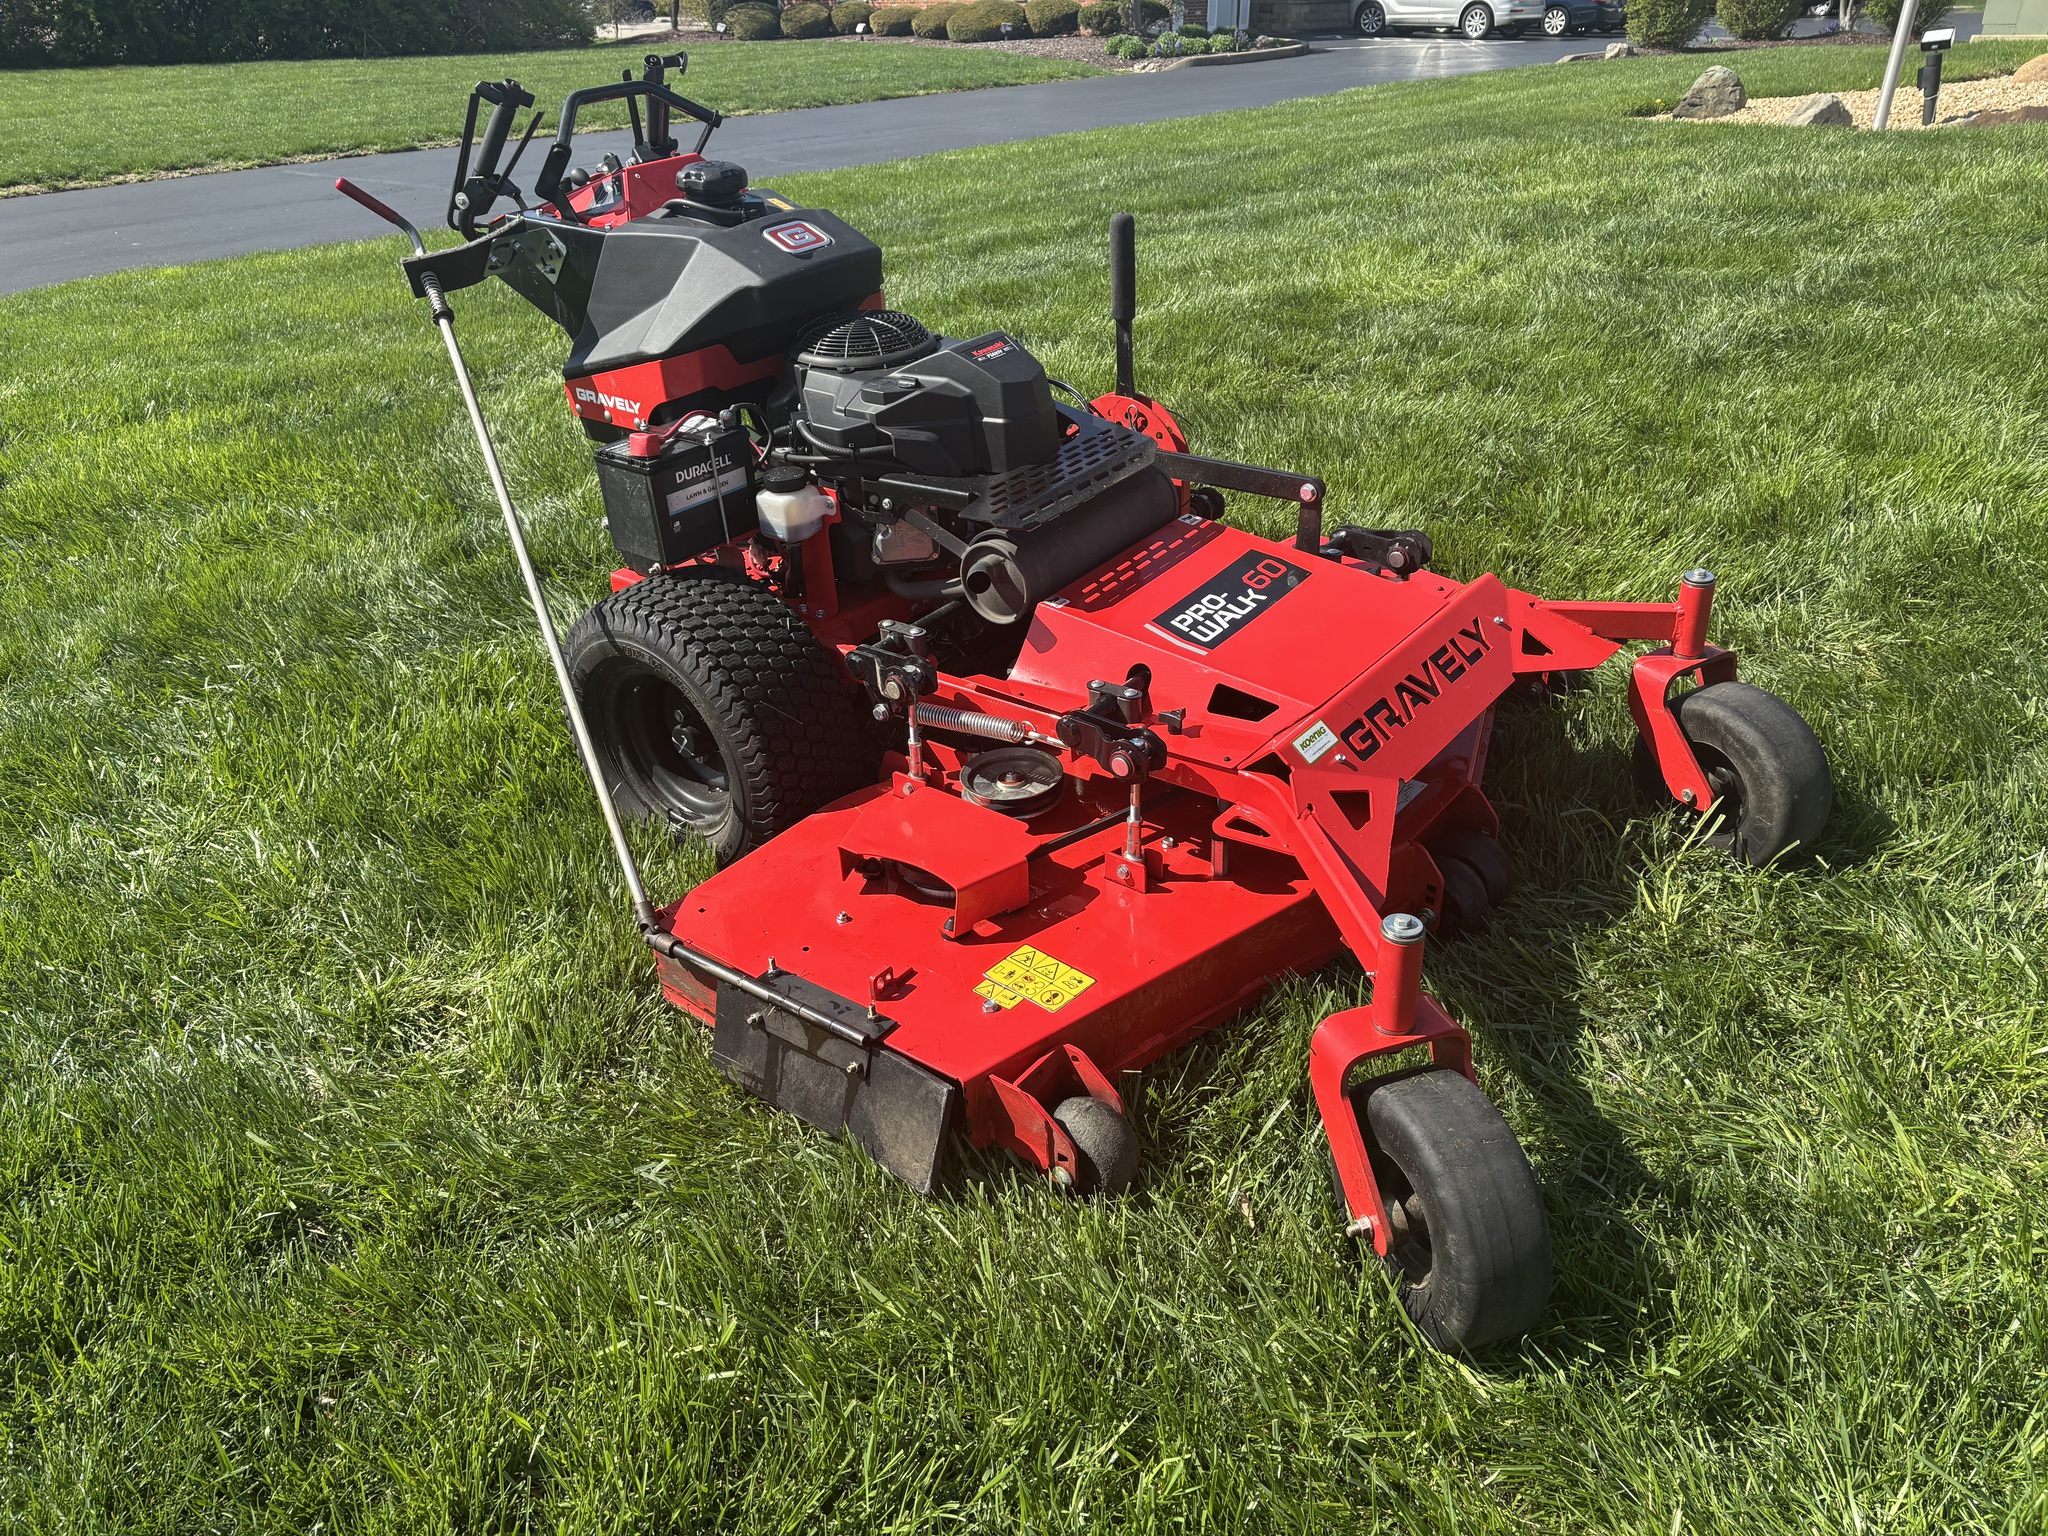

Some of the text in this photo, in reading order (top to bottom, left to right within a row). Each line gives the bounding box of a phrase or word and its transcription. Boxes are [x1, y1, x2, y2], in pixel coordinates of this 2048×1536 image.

[575, 387, 641, 415] GRAVELY
[686, 491, 703, 501] LAWN
[707, 480, 729, 493] GADEN
[1169, 592, 1229, 632] PRO-
[1189, 558, 1288, 642] WALK 60
[1339, 616, 1494, 762] GRAVELY
